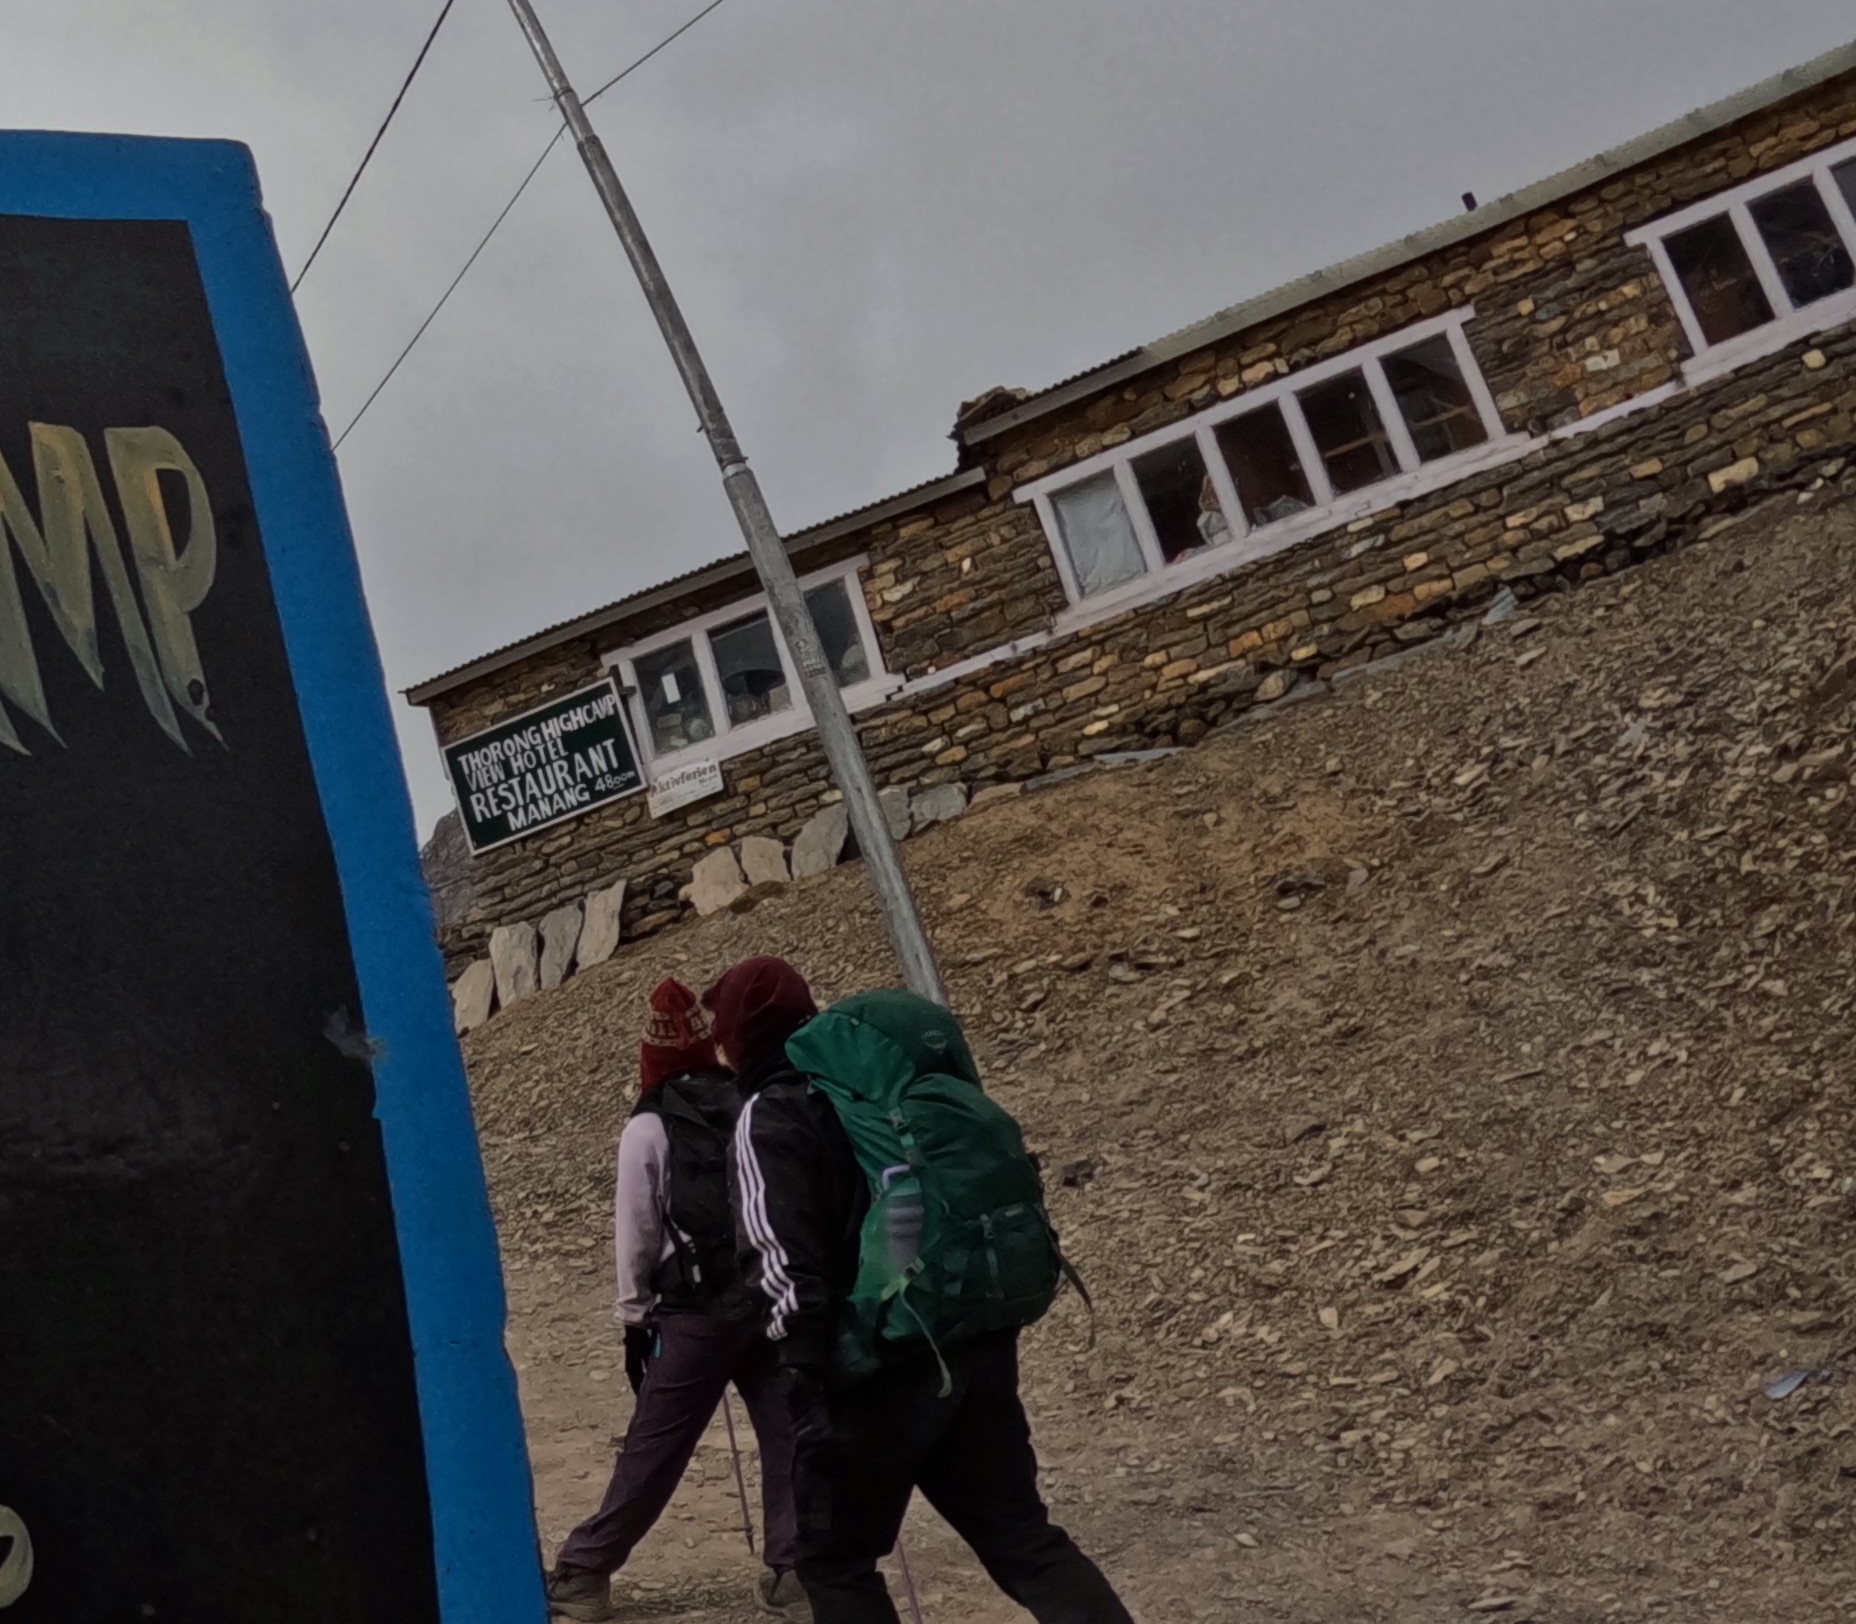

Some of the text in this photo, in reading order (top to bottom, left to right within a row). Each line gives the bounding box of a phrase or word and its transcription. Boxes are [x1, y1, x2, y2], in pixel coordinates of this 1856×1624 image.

[457, 726, 542, 775] THORONG
[465, 736, 569, 792] VIEW HOTEL
[469, 737, 619, 823] RESTAURANT
[506, 783, 591, 832] MANANG
